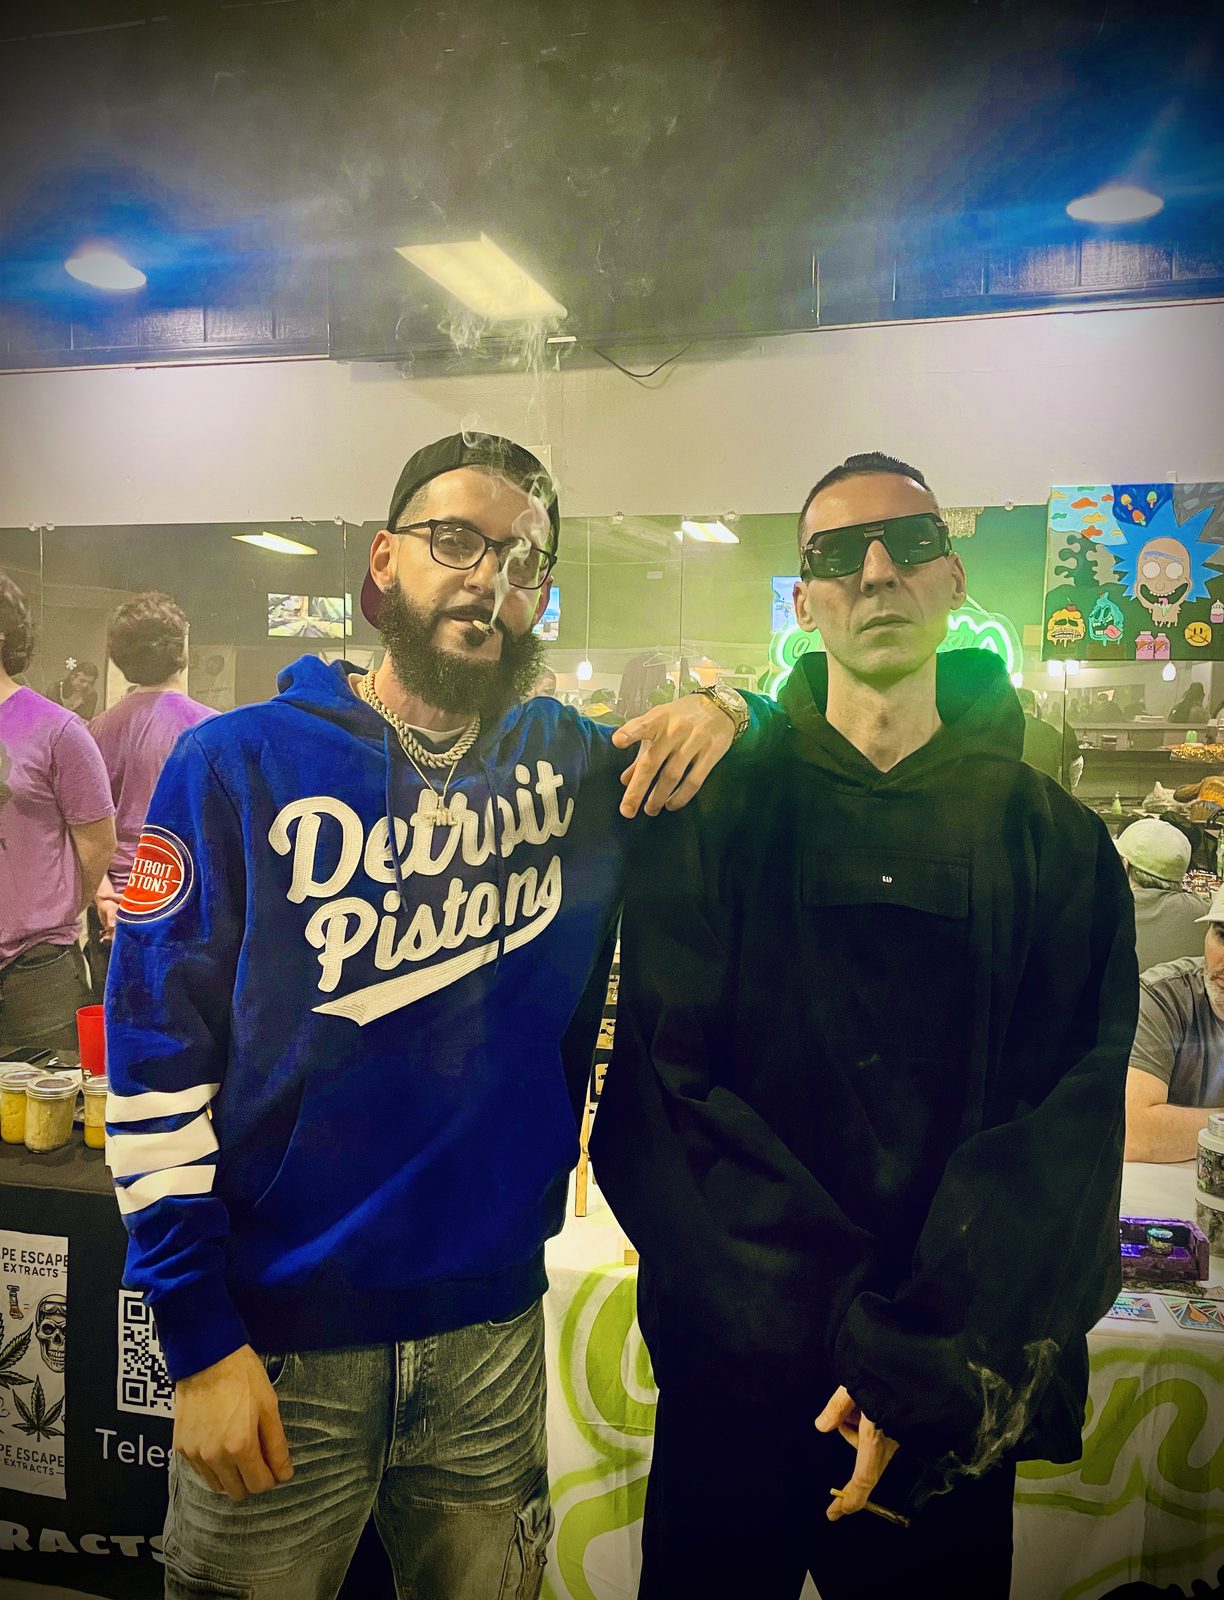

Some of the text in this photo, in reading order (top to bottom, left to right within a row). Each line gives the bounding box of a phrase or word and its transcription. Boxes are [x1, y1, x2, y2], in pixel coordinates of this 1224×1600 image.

[268, 760, 574, 904] Detroit
[304, 855, 562, 993] Pistons
[3, 1262, 59, 1278] EXTRACTS
[20, 1250, 69, 1268] ESCAPE
[16, 1446, 65, 1468] ESCAPE
[95, 1427, 172, 1472] Tele
[3, 1457, 55, 1476] EXTRACTS
